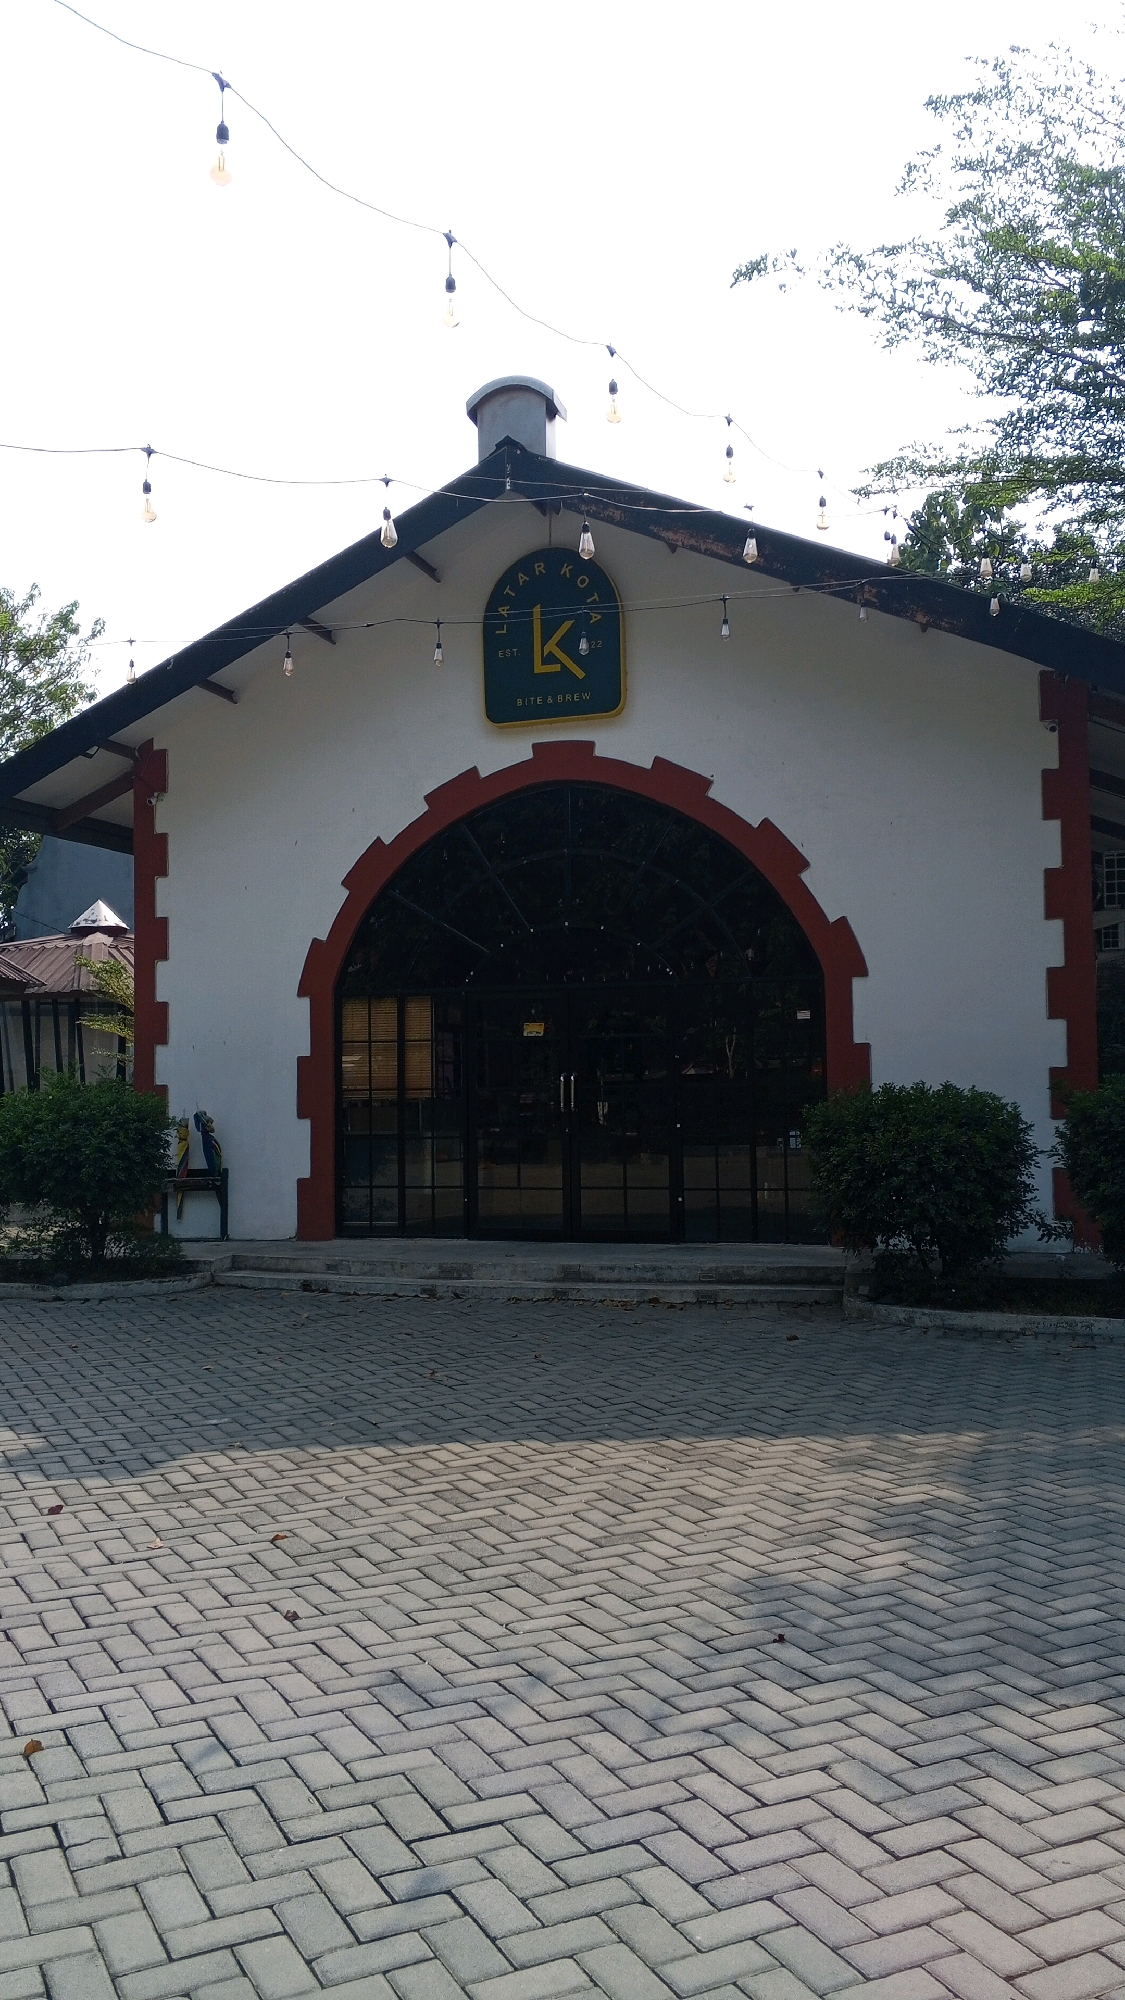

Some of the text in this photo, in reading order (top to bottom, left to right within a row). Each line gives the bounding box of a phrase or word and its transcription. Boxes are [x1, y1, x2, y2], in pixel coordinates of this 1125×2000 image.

[495, 562, 602, 634] LATAR KOTA
[498, 649, 520, 658] EST.
[516, 692, 591, 706] BITE & BREW
